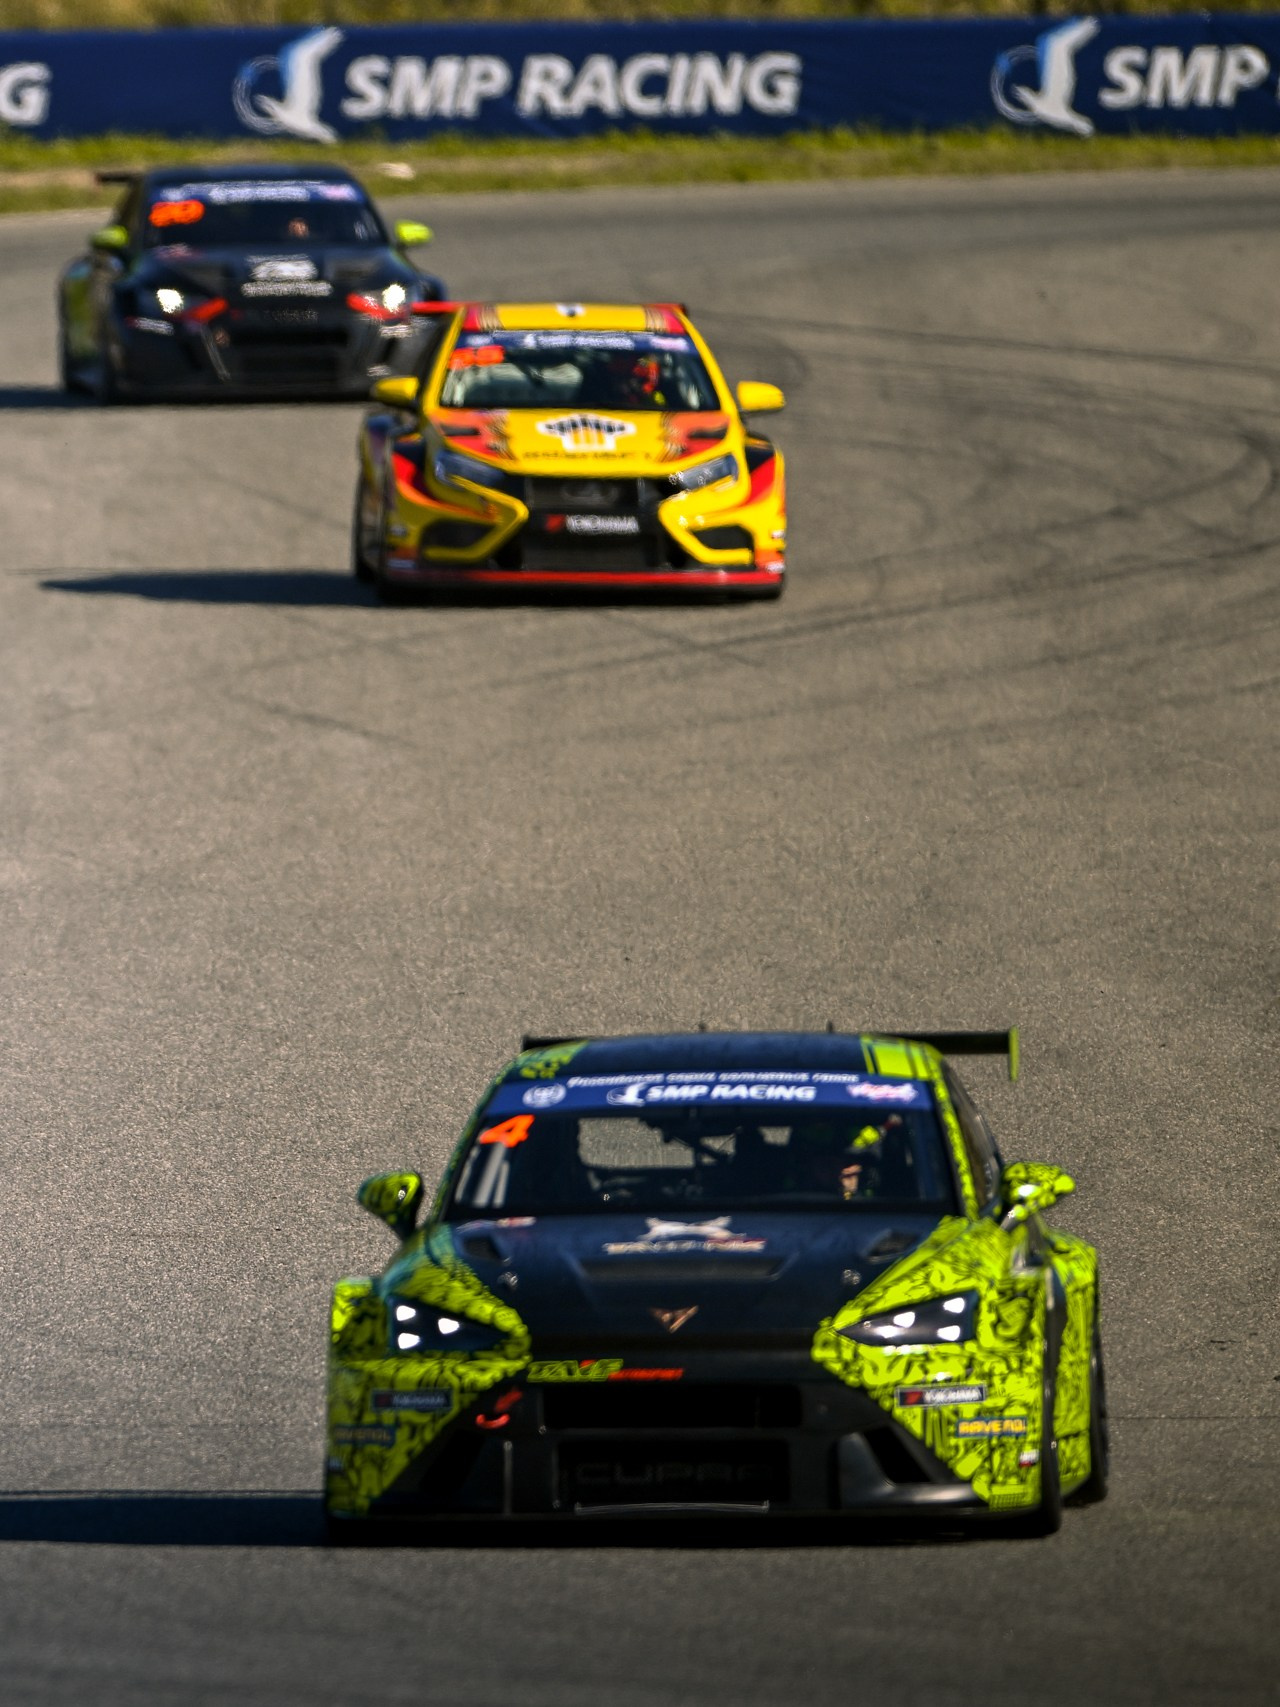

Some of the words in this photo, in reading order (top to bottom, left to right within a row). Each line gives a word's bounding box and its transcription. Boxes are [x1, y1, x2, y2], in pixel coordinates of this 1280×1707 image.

[341, 56, 510, 120] SMP
[514, 51, 802, 119] RACING
[1097, 45, 1270, 109] SMP
[646, 1083, 710, 1100] SMP
[710, 1083, 817, 1101] RACING
[479, 1114, 536, 1148] 4
